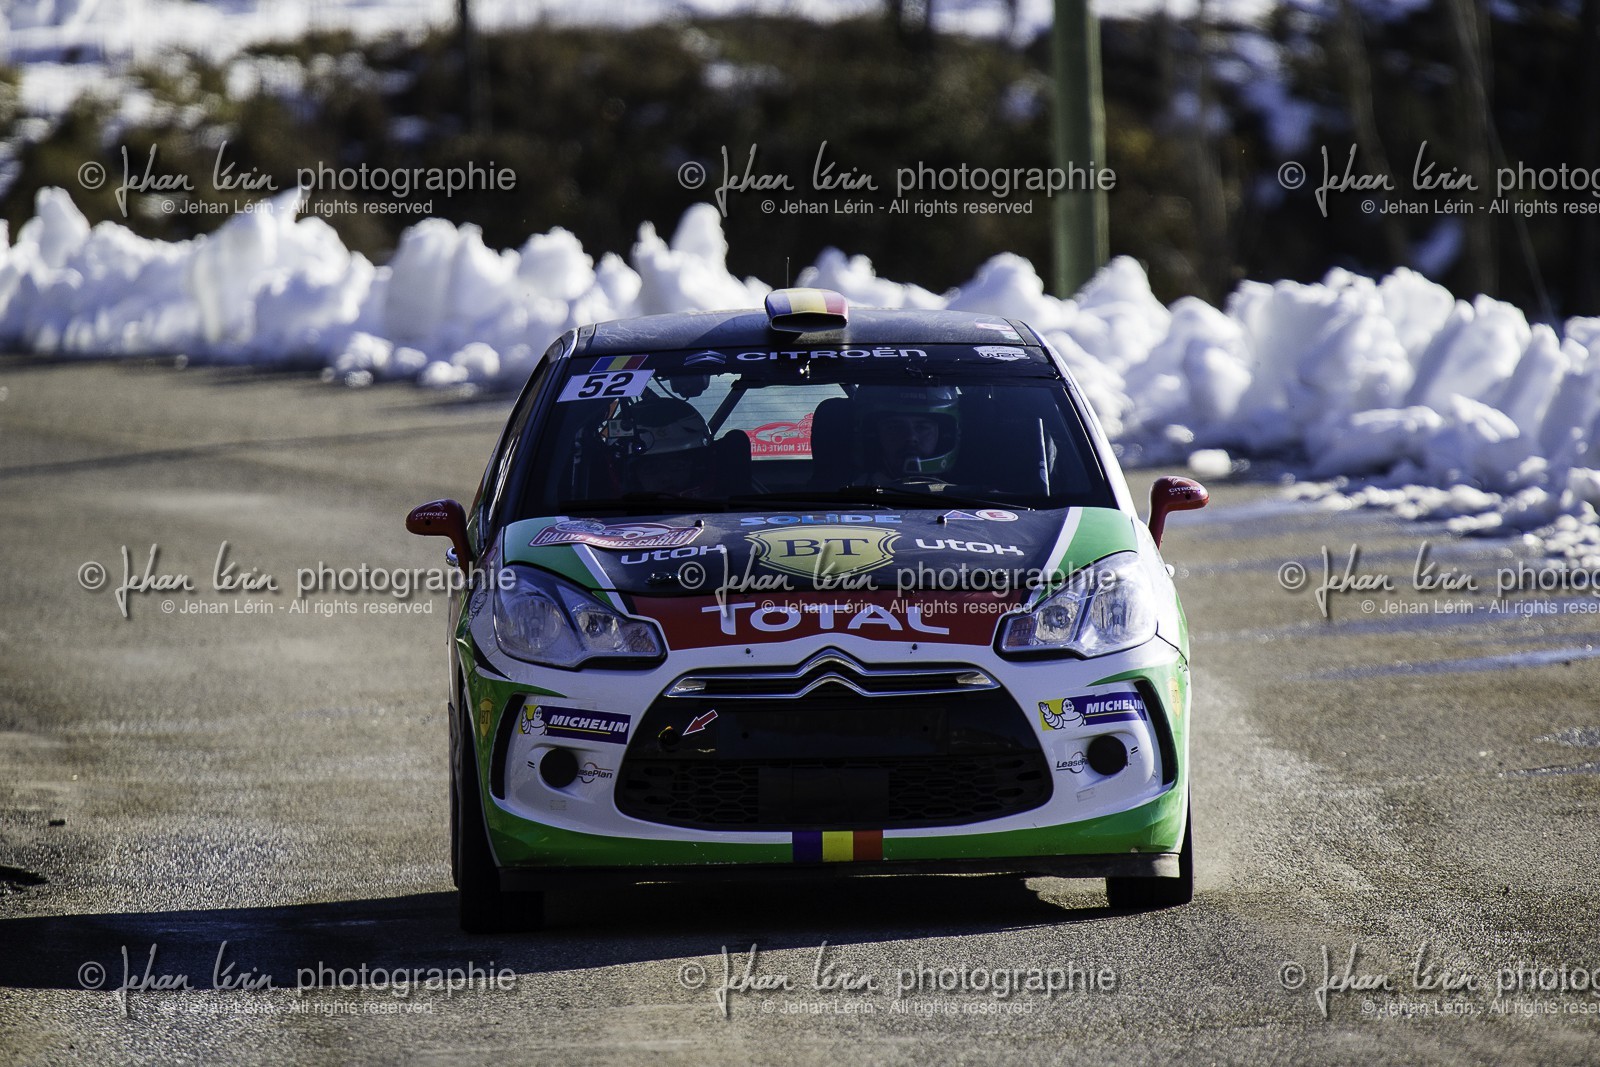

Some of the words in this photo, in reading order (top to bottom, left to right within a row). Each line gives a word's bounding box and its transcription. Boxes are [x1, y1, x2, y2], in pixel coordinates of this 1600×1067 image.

[736, 347, 928, 361] CITROËN
[578, 372, 634, 399] 52
[537, 531, 585, 544] RALLYE
[777, 538, 869, 557] BT
[701, 601, 949, 636] TOTAL
[1086, 699, 1143, 714] MICHELIN
[549, 714, 628, 733] MICHELIN
